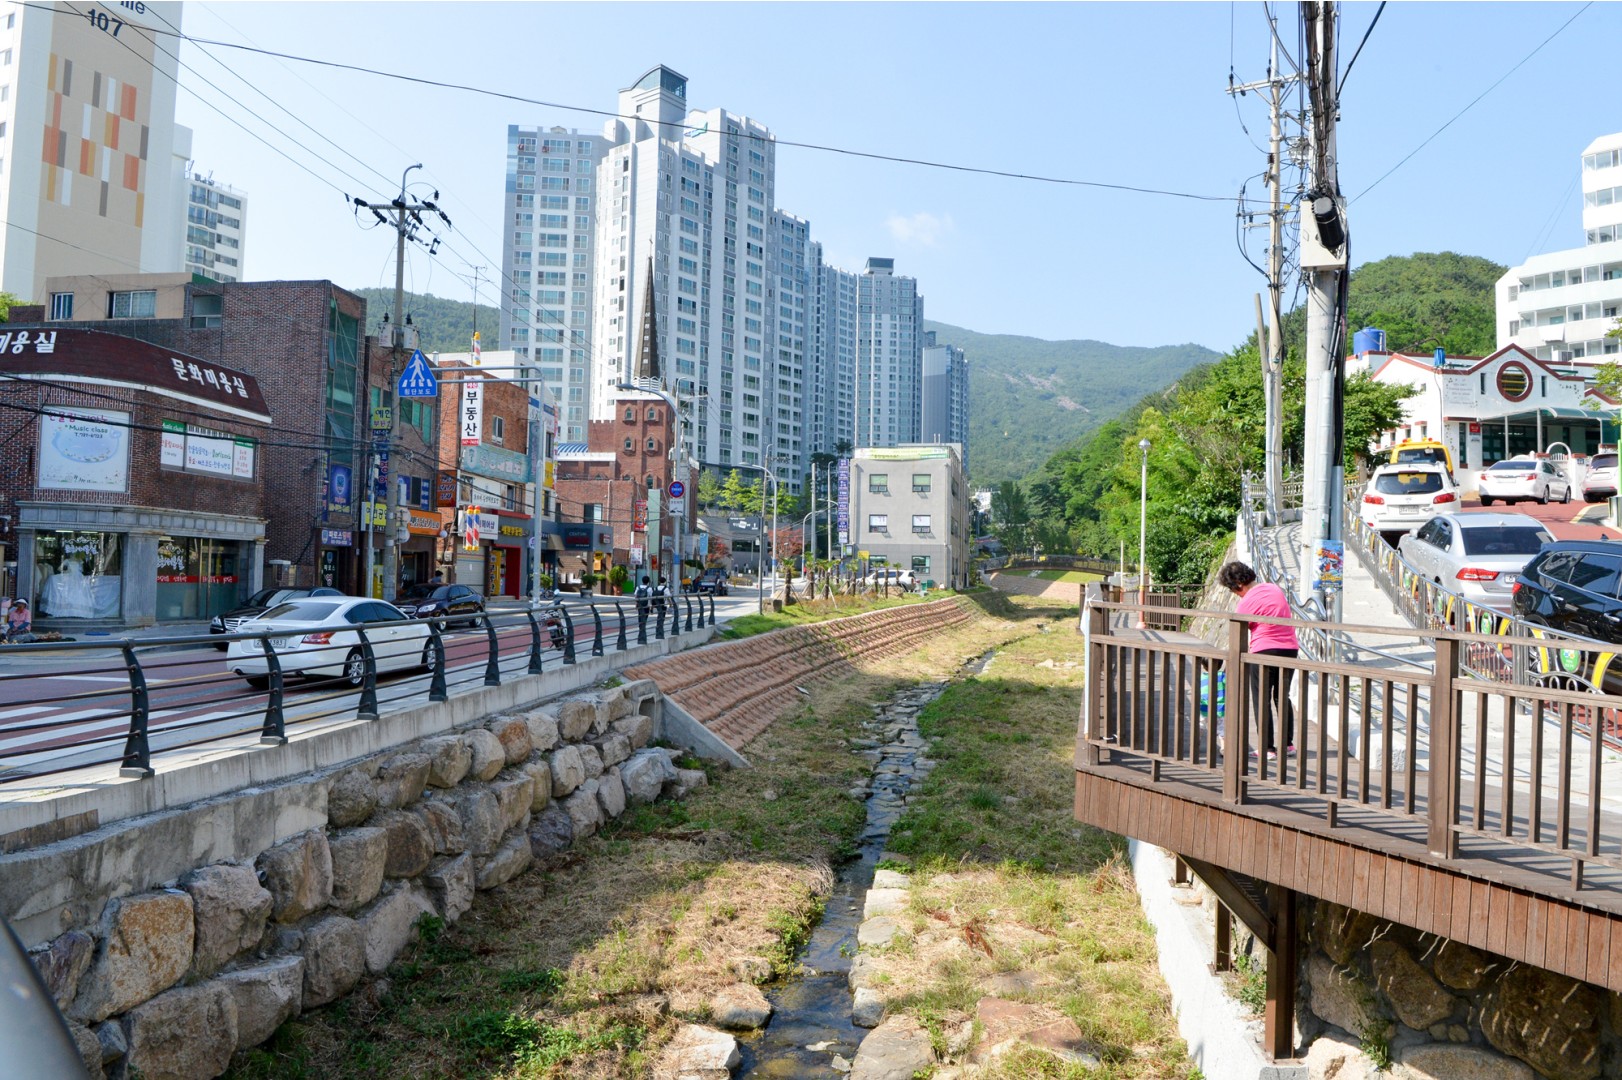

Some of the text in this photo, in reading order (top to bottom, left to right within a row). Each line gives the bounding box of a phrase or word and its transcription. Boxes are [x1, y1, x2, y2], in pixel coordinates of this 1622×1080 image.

[87, 8, 123, 37] 107
[171, 357, 249, 399] 문화미용실
[464, 391, 478, 437] 부동산
